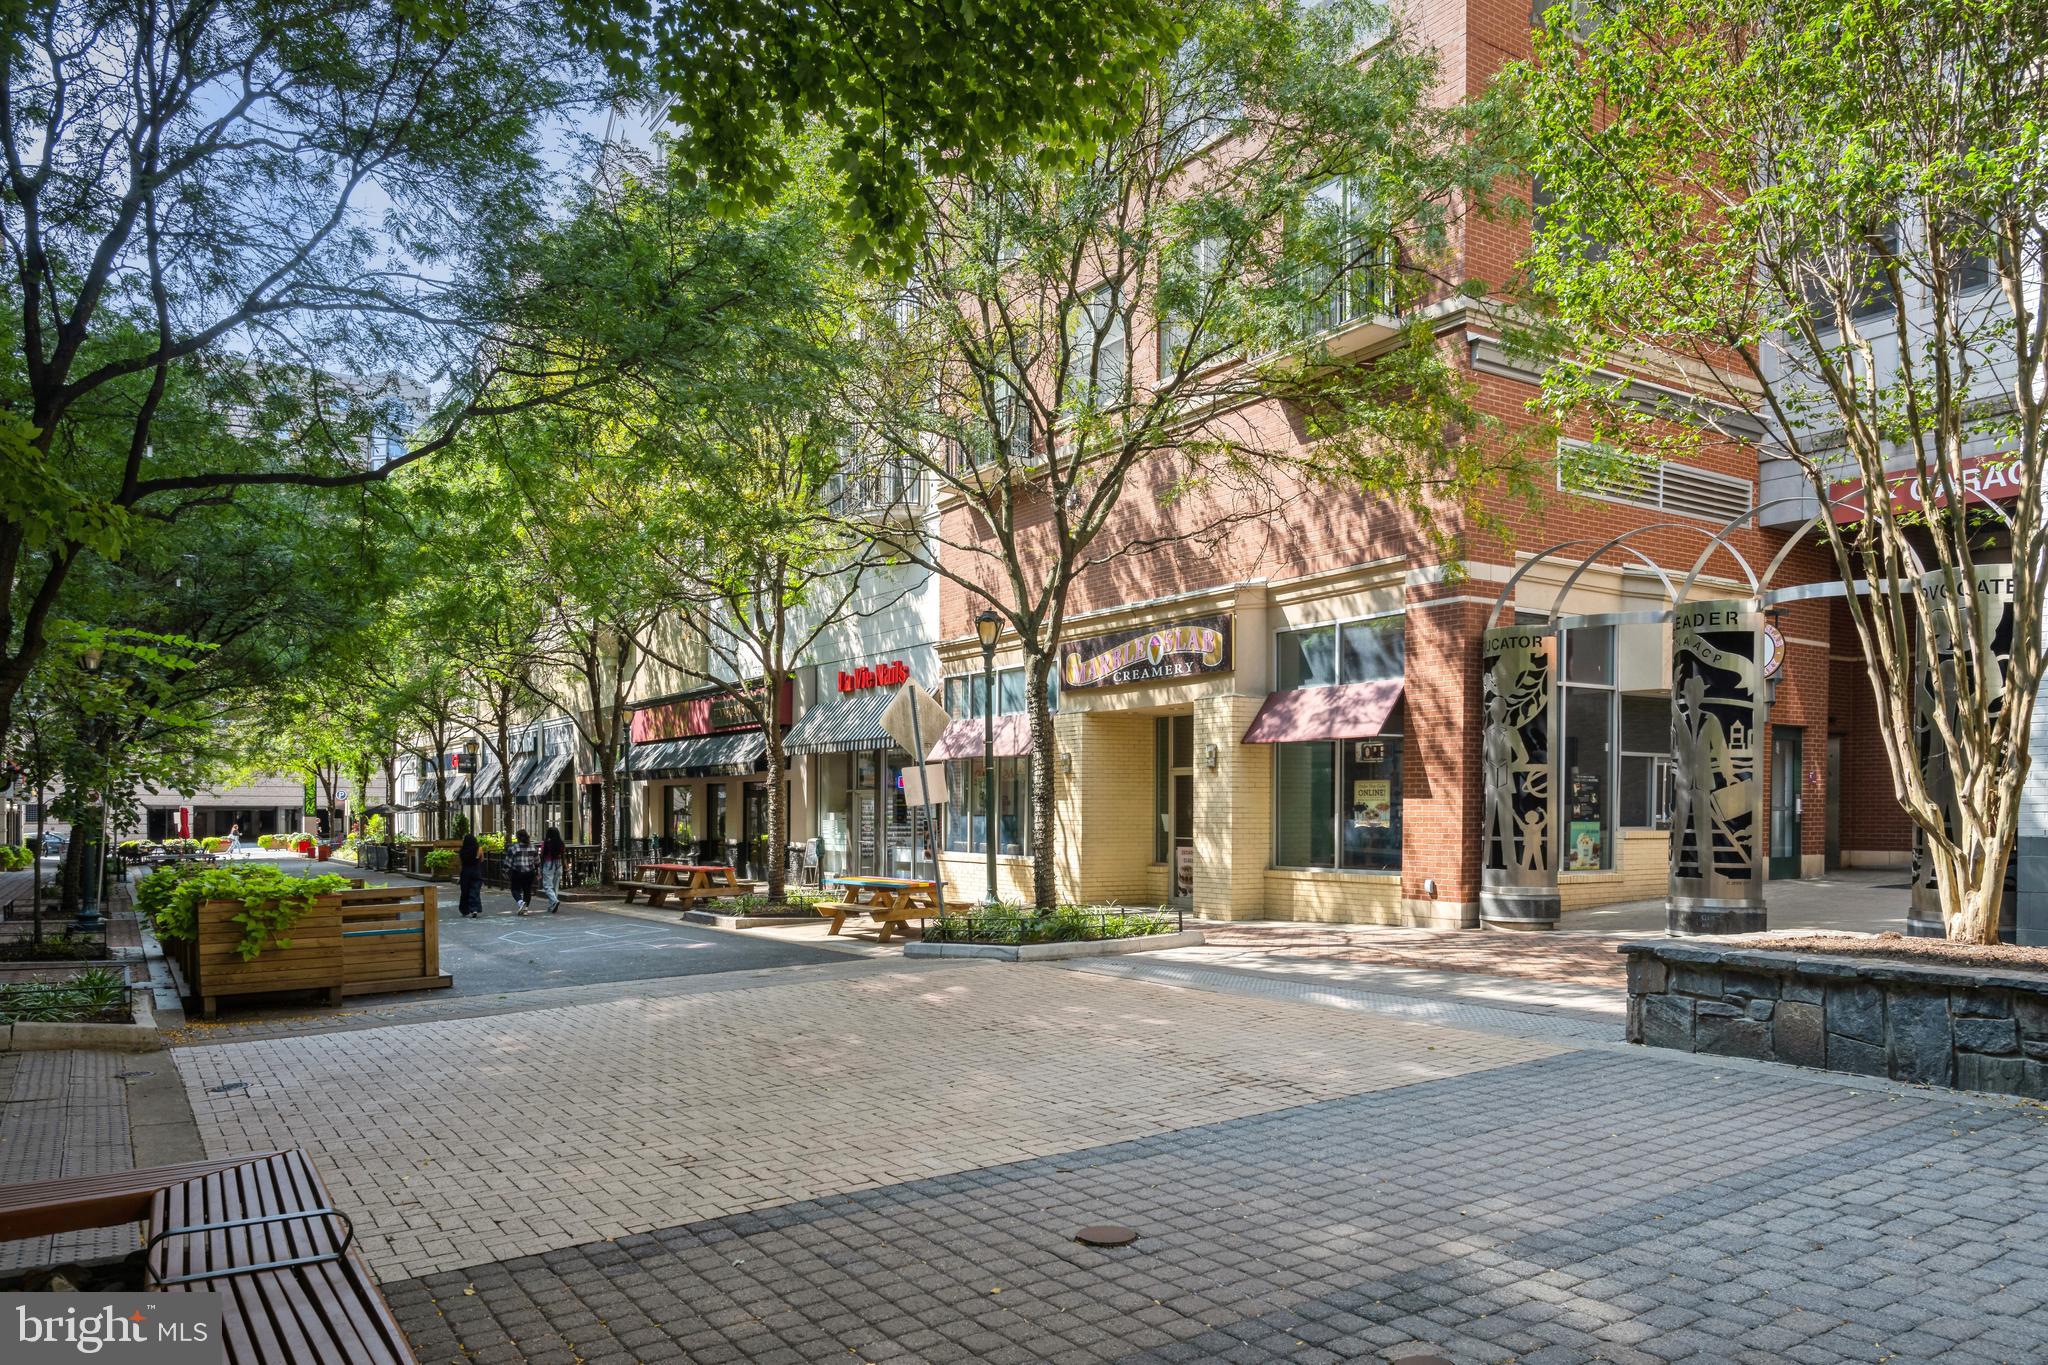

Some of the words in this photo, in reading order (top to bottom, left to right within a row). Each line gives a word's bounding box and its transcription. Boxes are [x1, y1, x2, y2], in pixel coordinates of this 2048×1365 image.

[1673, 611, 1738, 631] EADER
[1072, 638, 1146, 682] MARBLE
[1164, 629, 1215, 653] SLAB
[838, 671, 855, 692] La
[854, 666, 876, 689] Vie
[876, 660, 910, 687] Nails
[1113, 661, 1194, 682] CREAMERY
